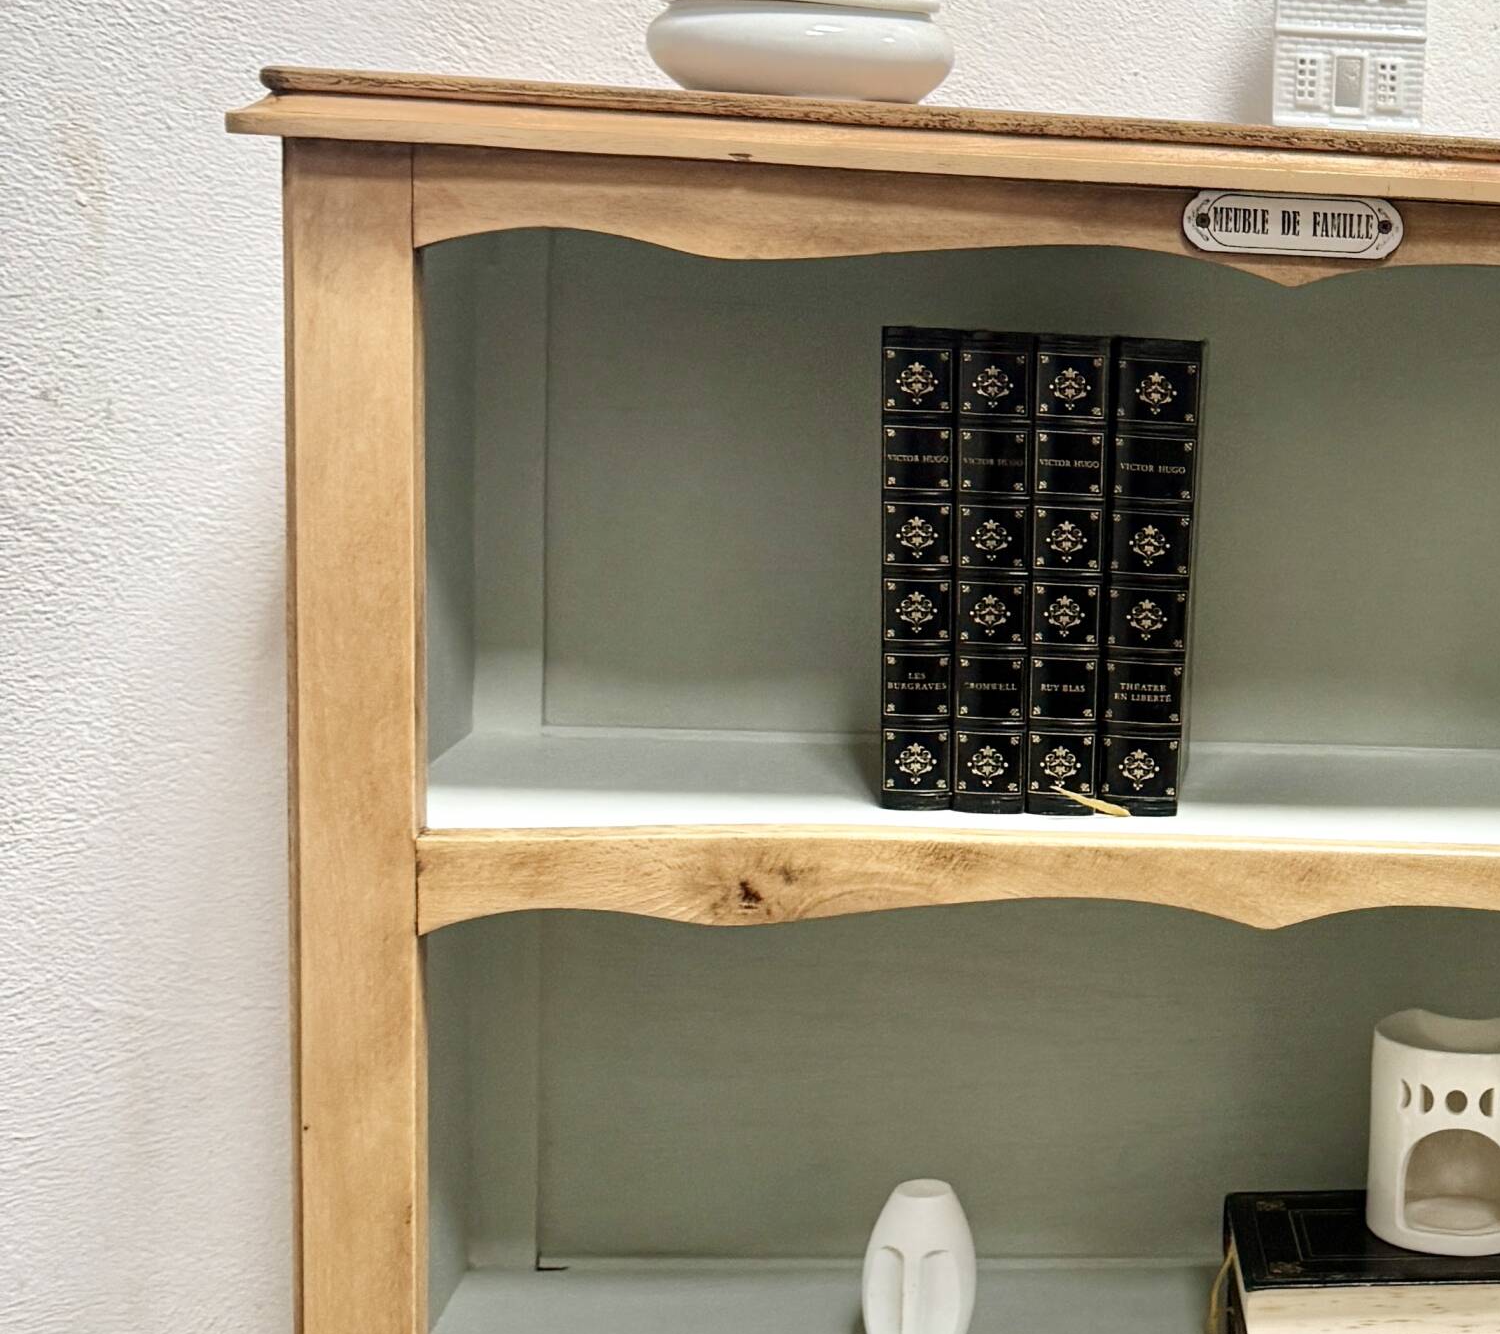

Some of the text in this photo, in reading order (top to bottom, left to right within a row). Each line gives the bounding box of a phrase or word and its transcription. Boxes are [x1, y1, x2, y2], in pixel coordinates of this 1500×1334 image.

[1212, 205, 1373, 240] MEUBLE DE FAMILLE
[887, 454, 949, 464] VICTOR HUGO
[1039, 458, 1100, 469] VICTOR HUGO
[1120, 462, 1186, 474] VICTOR HUGO
[908, 672, 926, 680] LES
[1040, 683, 1060, 692] RUY
[1114, 692, 1128, 701] EN
